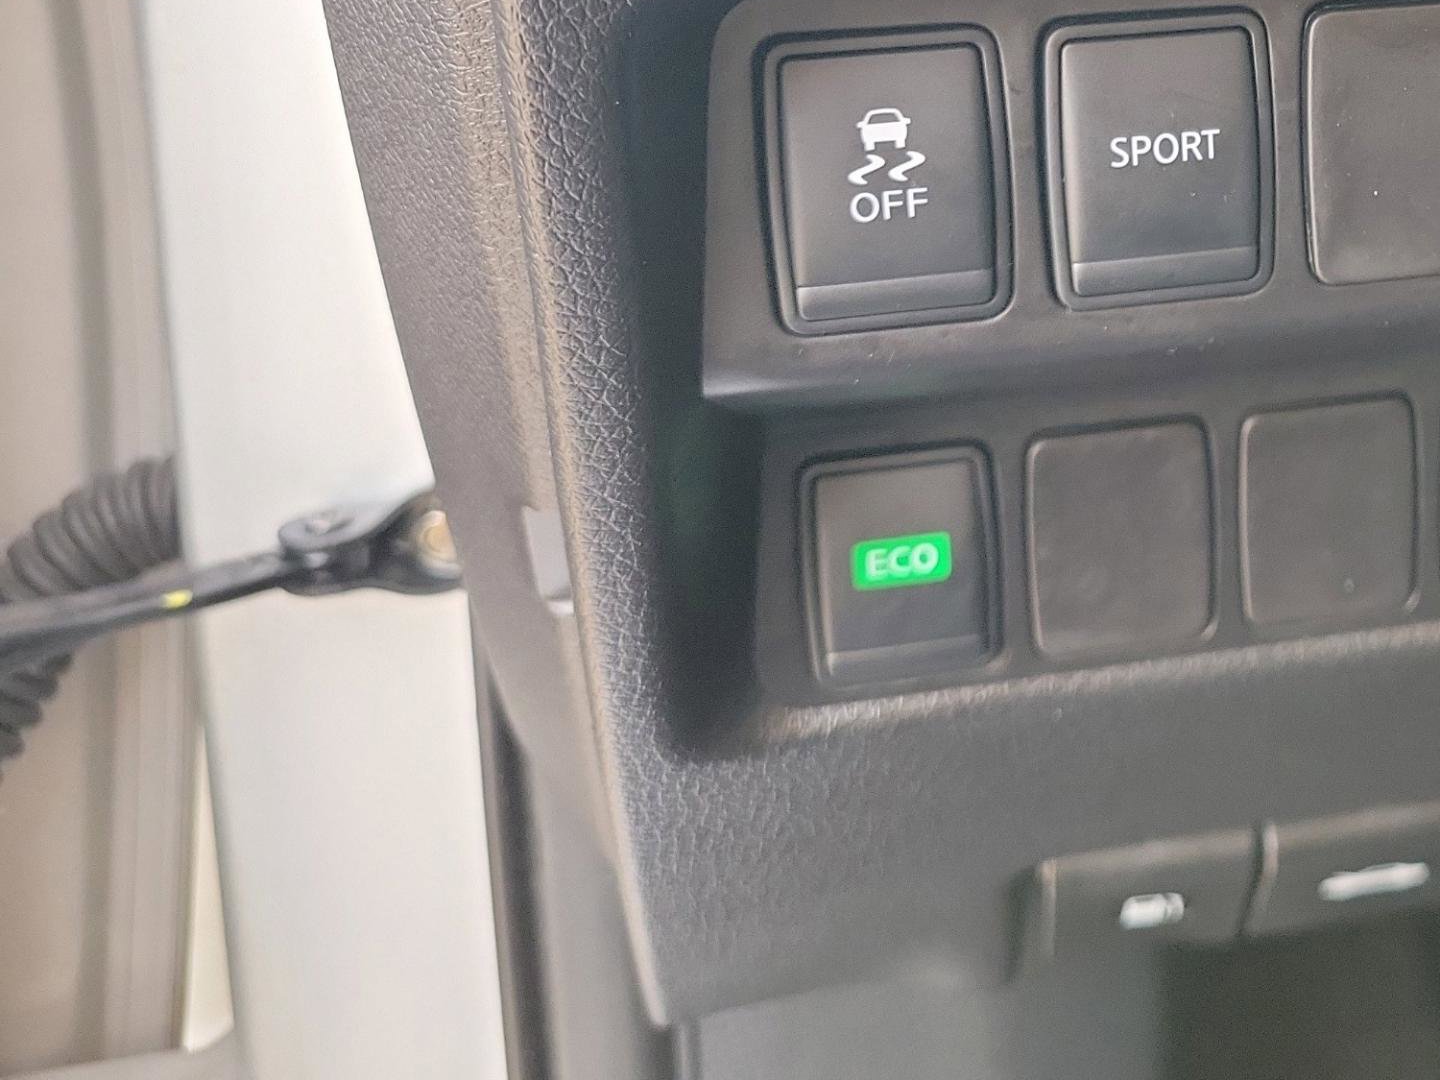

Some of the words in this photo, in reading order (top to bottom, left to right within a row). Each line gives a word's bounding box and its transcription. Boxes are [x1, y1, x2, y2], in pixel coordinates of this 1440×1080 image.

[1109, 128, 1221, 169] SPORT
[849, 186, 928, 223] OFF
[864, 542, 940, 581] ECO
